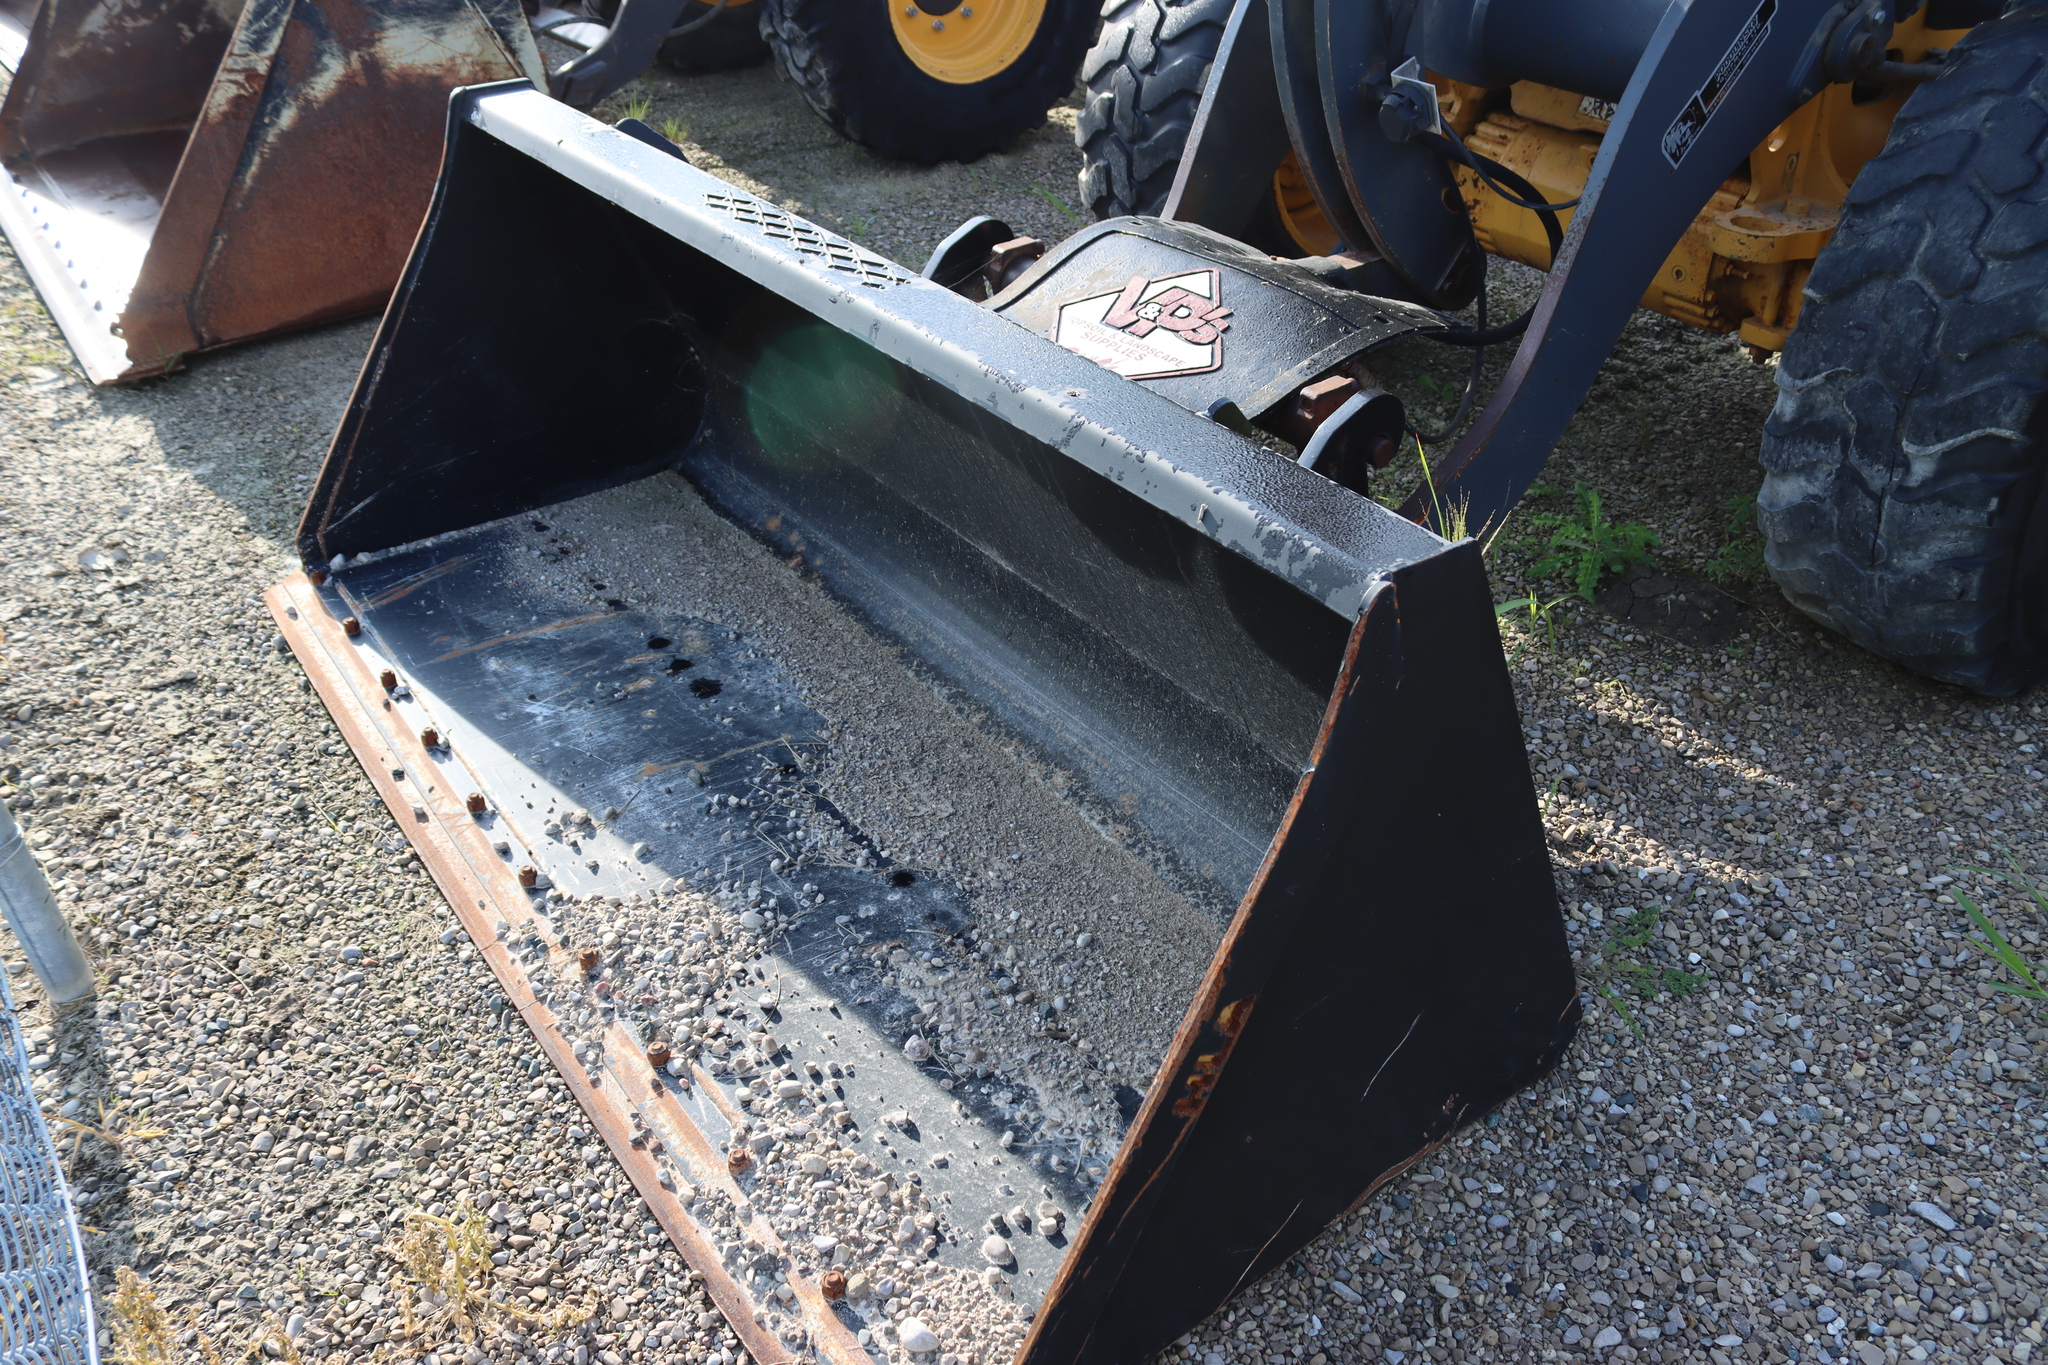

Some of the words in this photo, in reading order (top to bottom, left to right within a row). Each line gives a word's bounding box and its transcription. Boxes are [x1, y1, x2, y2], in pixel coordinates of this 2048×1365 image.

[1713, 13, 1760, 81] PODOLINSKY
[1715, 39, 1749, 88] EQUIPMENT
[1080, 331, 1147, 361] SUPPLIES
[1119, 335, 1186, 368] LANDSCAPE
